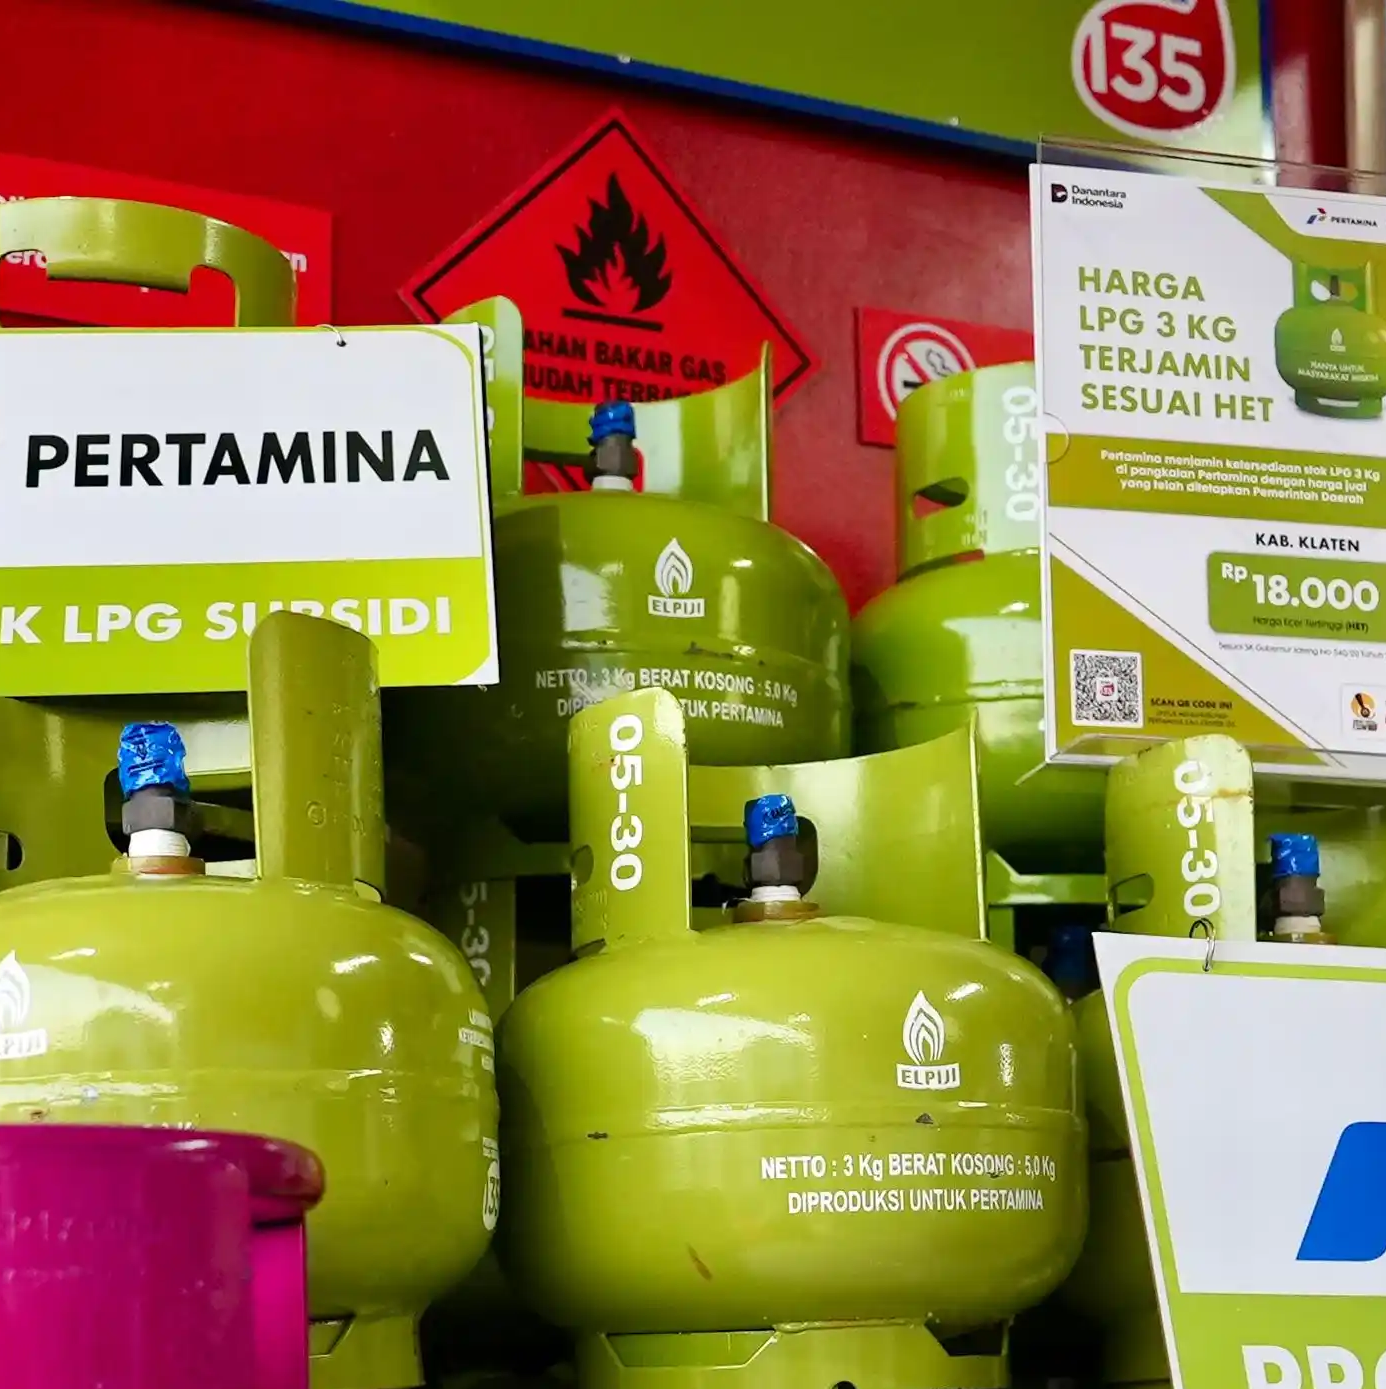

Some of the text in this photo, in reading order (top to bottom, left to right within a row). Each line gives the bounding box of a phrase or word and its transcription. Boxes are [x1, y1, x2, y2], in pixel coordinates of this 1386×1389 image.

[1085, 18, 1205, 112] 135
[1072, 184, 1126, 199] Danantara
[1072, 195, 1123, 209] Indonesia
[1331, 216, 1378, 227] PERTAMINA
[1078, 266, 1205, 301] HARGA
[1079, 305, 1237, 343] LPG 3 KG
[524, 329, 726, 385] AHAN BAKAR GAS
[1079, 344, 1251, 382] TERJAMIN
[524, 364, 593, 397] UDAH
[1081, 383, 1273, 422] SESUAI HET
[25, 429, 451, 488] PERTAMINA
[1100, 449, 1380, 482] Pertamina menjamin ketersediaan stok LPG 3 Kg
[1116, 464, 1367, 493] di pangkalan Pertamina dengan harga jual
[1121, 479, 1364, 504] yang telah ditetapkan Pemerintah Daerah
[1256, 533, 1360, 551] KAB. KLATEN
[1221, 562, 1379, 611] Rp 18.000
[651, 600, 702, 614] ELPIJI
[63, 602, 182, 644] LPG
[1346, 621, 1369, 633] (HET)
[640, 669, 754, 695] BERAT KOSONG
[713, 701, 784, 728] PERTAMINA
[609, 714, 643, 891] 05-30
[1174, 760, 1221, 917] 05-30
[901, 1068, 956, 1086] ELPIJI
[761, 1154, 1055, 1181] NETTO 3 Kg BERAT KOSONG 5,0 Kg
[788, 1189, 1043, 1213] DIPRODUKSI UNTUK PERTAMINA
